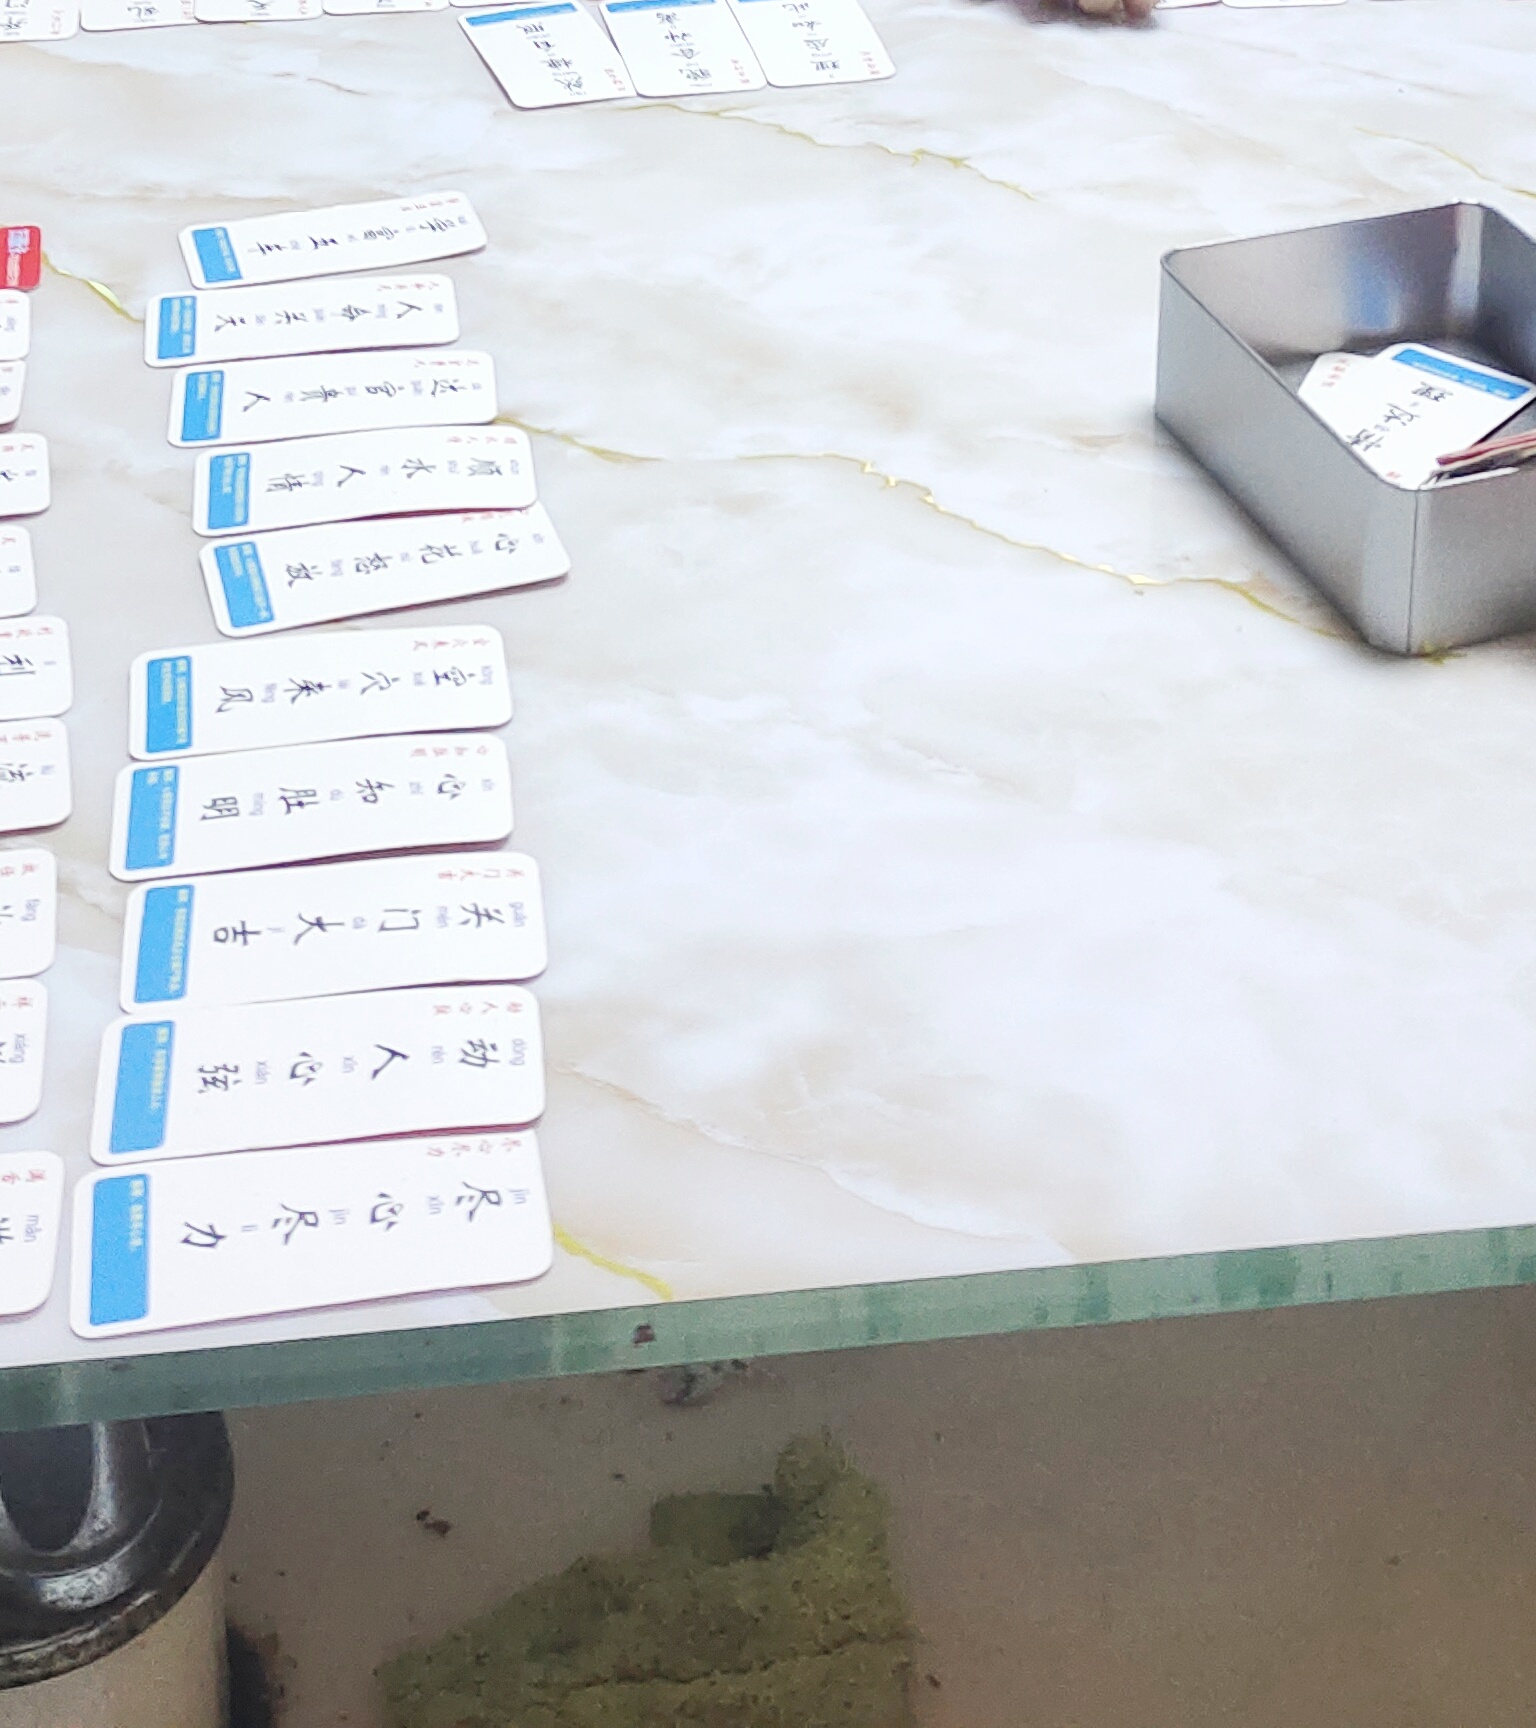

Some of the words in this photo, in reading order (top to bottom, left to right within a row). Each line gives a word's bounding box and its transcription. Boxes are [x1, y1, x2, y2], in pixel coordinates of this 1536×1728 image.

[247, 213, 458, 255] 学富五车
[214, 301, 424, 332] 人命关天
[242, 377, 460, 412] 达官贵人
[266, 457, 502, 494] 顺水人情
[285, 533, 520, 588] 心花怒放
[215, 666, 473, 714] 空穴来风
[199, 773, 467, 821] 心知肚明
[213, 903, 504, 947] 关门大吉
[197, 1038, 498, 1093] 动人心弦
[180, 1181, 502, 1249] 尽心尽力
